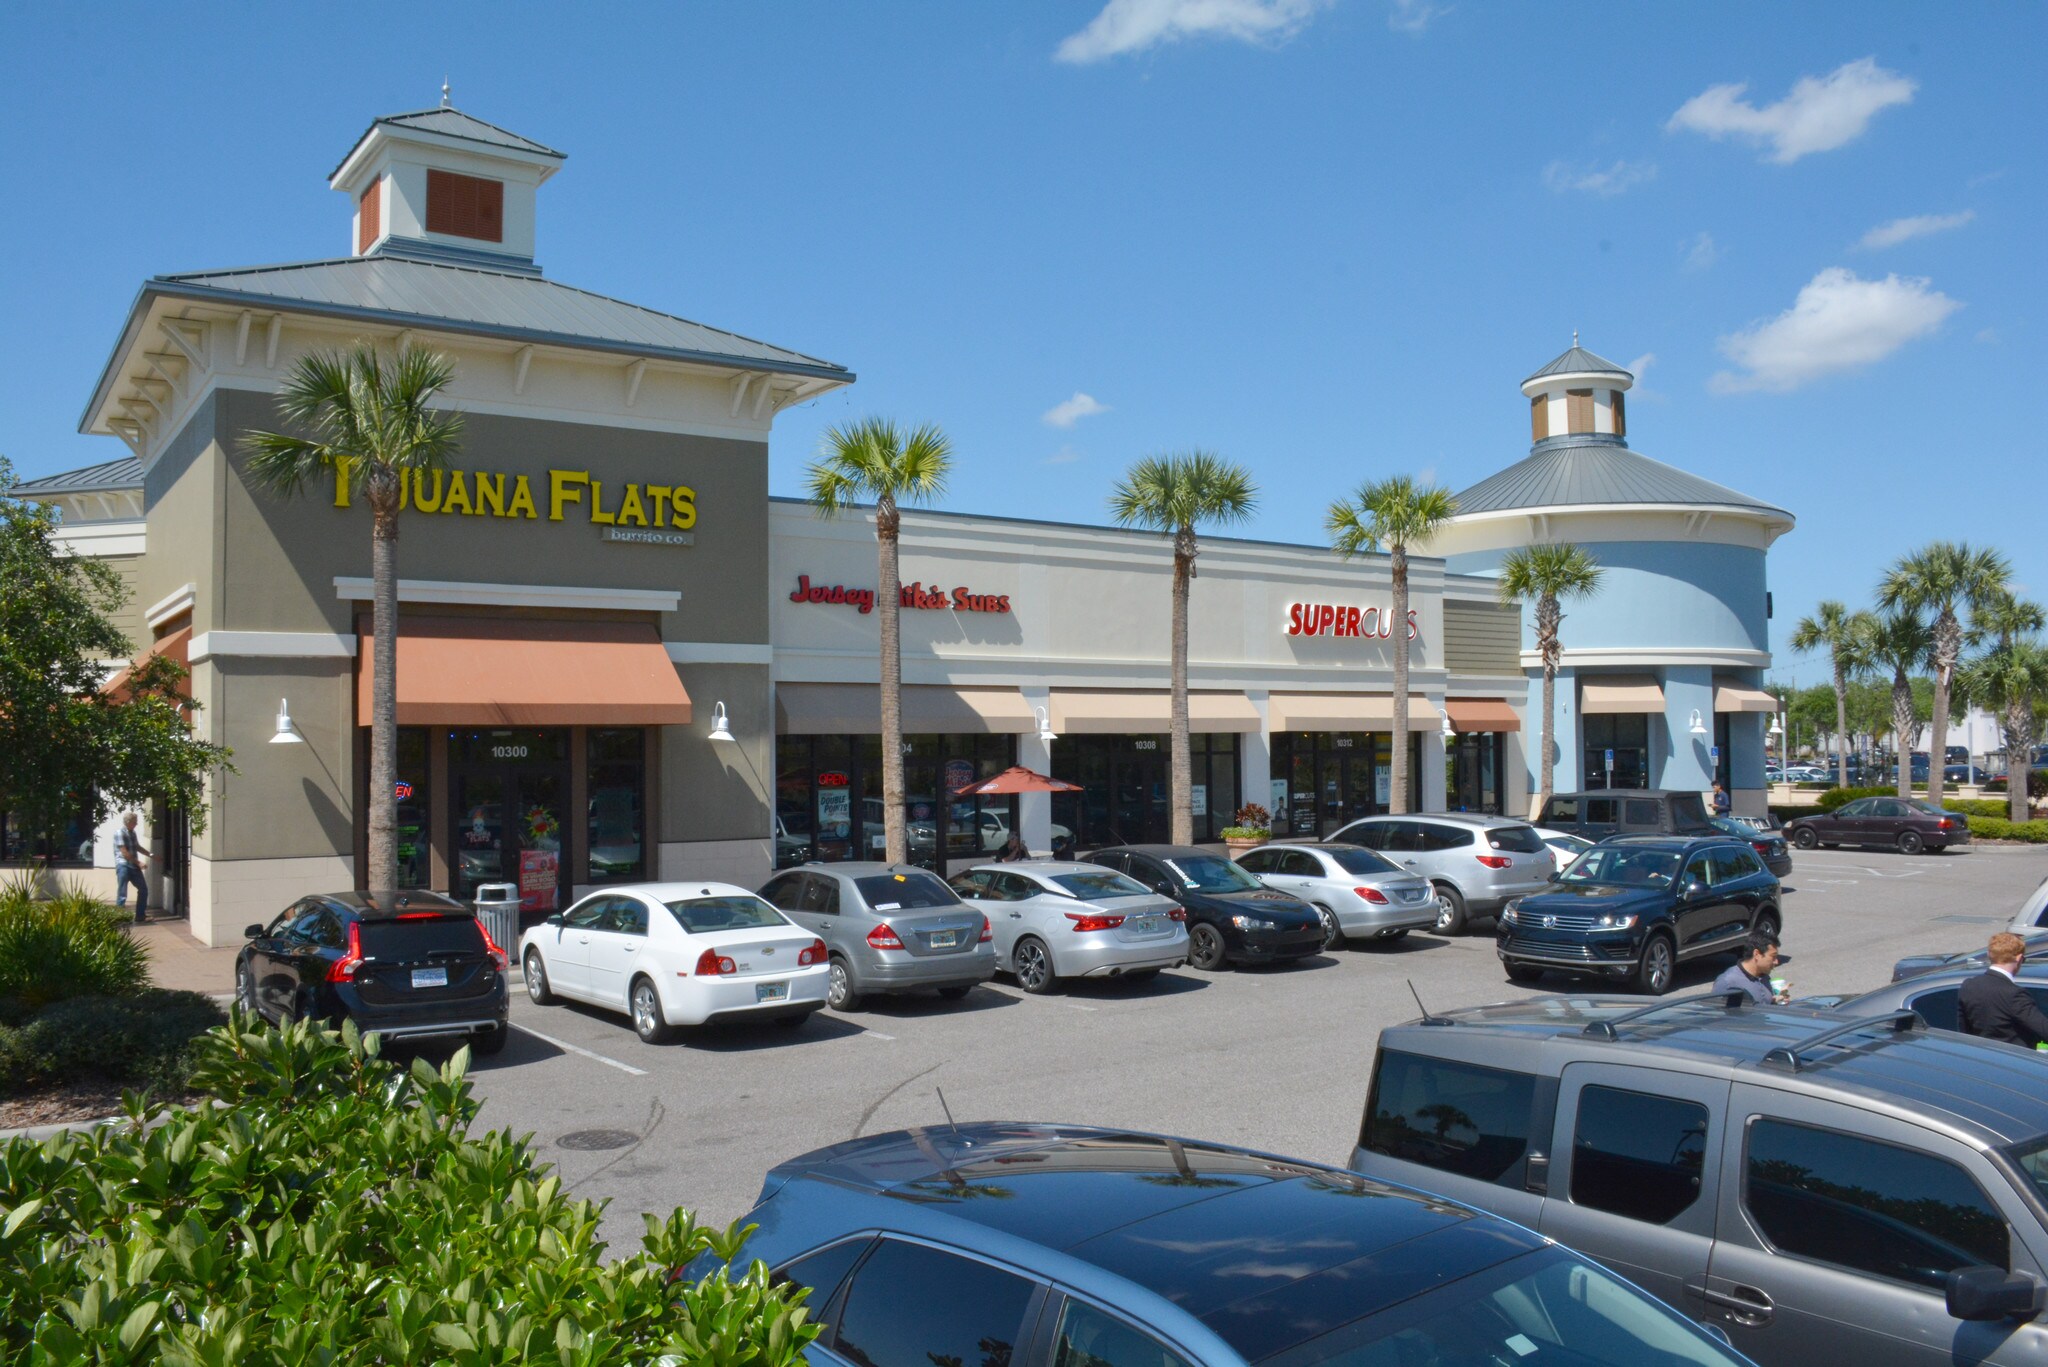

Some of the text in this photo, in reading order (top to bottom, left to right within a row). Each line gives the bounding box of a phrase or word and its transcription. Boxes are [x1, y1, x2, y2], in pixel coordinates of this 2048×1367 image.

[548, 469, 697, 530] FLATS
[611, 528, 663, 543] burrito
[791, 575, 874, 614] Jersey
[878, 581, 950, 609] ike's
[1289, 603, 1417, 640] SUPERCUS
[491, 745, 528, 758] 10300
[1135, 740, 1157, 750] 10308
[819, 773, 848, 785] OPEN
[396, 786, 413, 797] EN
[820, 795, 847, 805] DOUBLE
